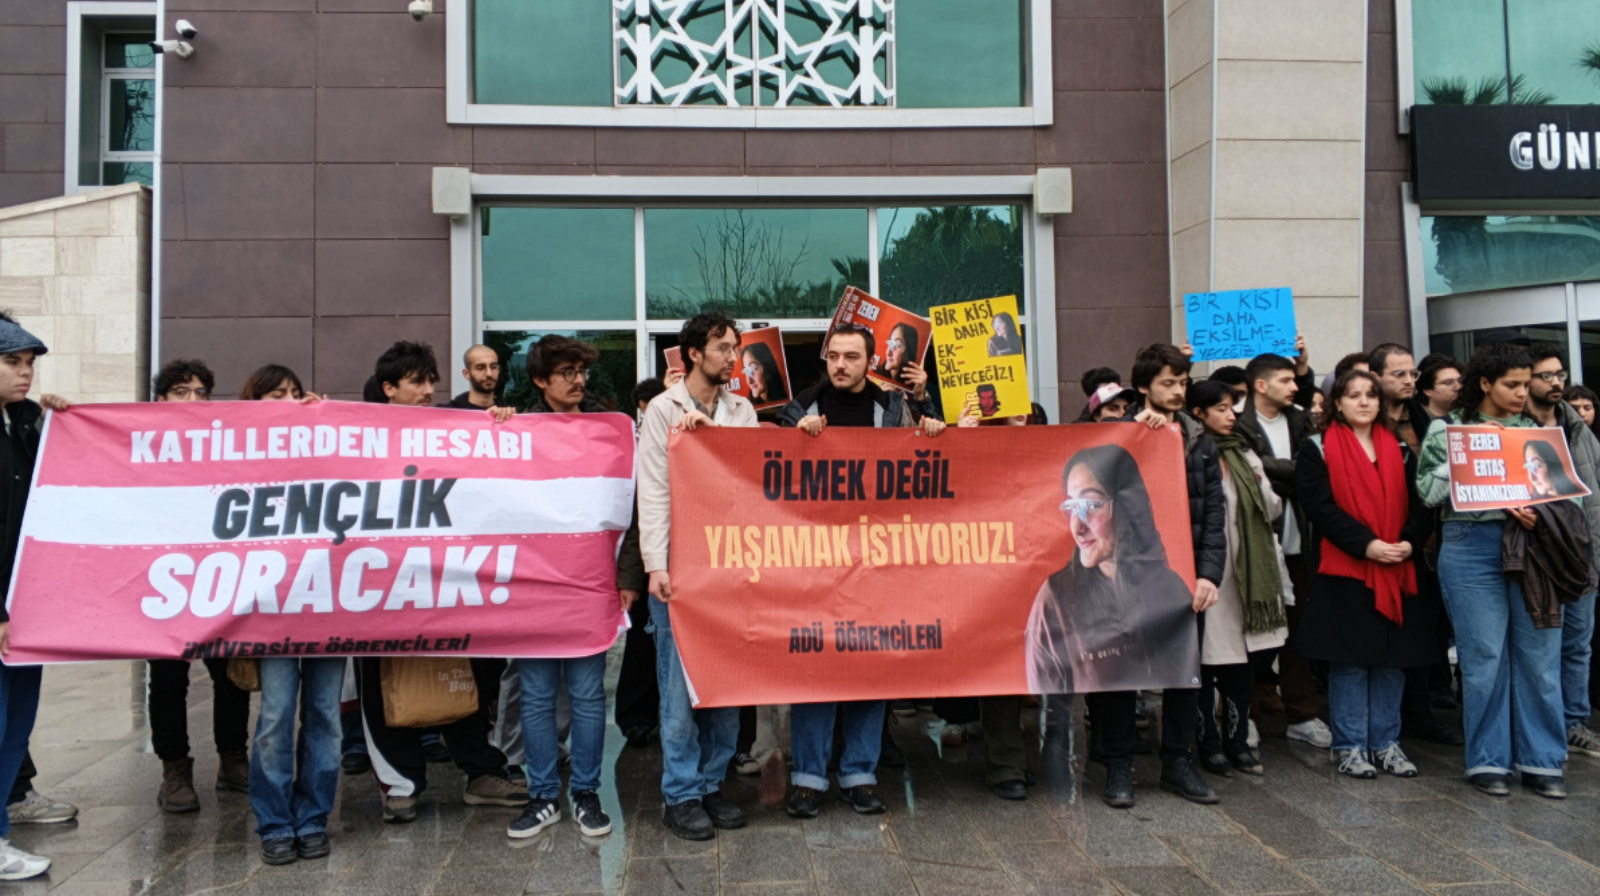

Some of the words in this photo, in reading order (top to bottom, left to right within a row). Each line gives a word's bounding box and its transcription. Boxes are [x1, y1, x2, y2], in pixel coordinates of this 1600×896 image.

[1509, 123, 1600, 170] GÜN
[934, 308, 958, 326] BİR
[964, 300, 994, 321] KİŞİ
[1188, 293, 1220, 312] BİR
[954, 323, 988, 341] DAHA
[1213, 312, 1257, 326] DAHA
[941, 365, 1014, 389] MEYECEĞİZ!
[130, 419, 389, 463] KATİLLERDEN
[401, 428, 533, 461] HESABI
[1469, 433, 1500, 450] ZEREN
[763, 451, 865, 501] ÖLMEK
[877, 449, 954, 500] DEĞİL
[1475, 459, 1506, 481] ERTAŞ
[212, 465, 457, 544] GENÇLİK
[705, 525, 850, 583] YAŞAMAK
[860, 514, 1016, 567] İSTİYORUZ!
[141, 545, 517, 620] SORACAK!
[181, 637, 320, 659] ÜNİVERSİTE
[325, 633, 472, 654] ÖĞRENCİLERİ
[789, 621, 824, 653] ADÜ
[834, 618, 943, 652] ÖĞRENCİLERİ
[449, 681, 473, 692] Bag
